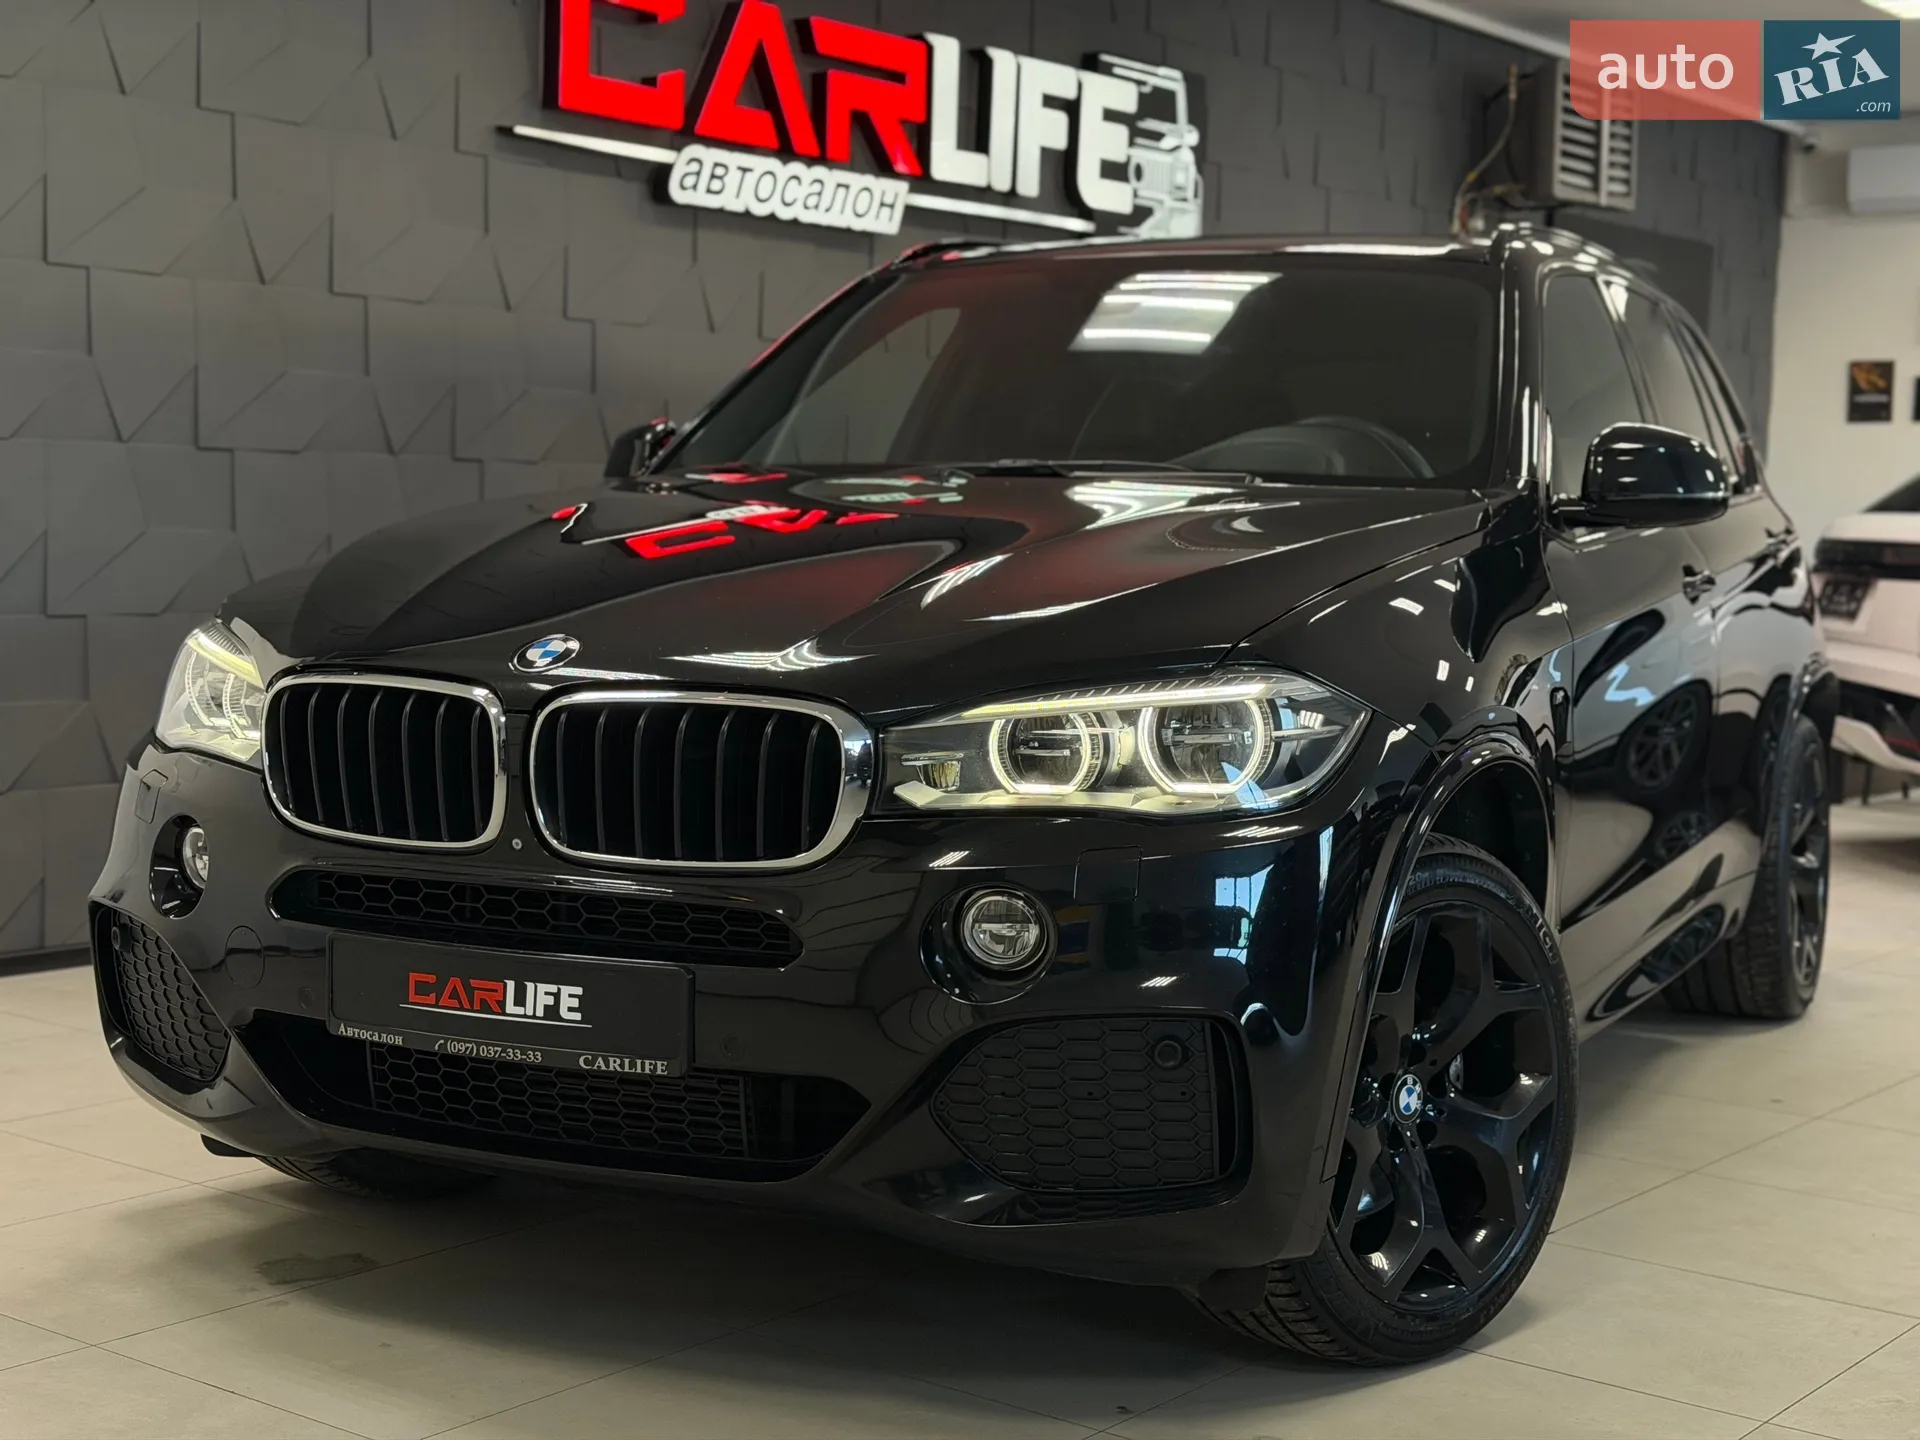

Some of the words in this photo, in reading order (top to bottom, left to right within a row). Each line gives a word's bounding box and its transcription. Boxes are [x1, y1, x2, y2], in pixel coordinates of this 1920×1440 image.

[678, 157, 903, 223] автосалон
[408, 972, 584, 1021] CARLIFE
[338, 1022, 404, 1045] Автосалон
[447, 1039, 477, 1057] (097)
[479, 1045, 542, 1063] 037-33-33
[579, 1054, 668, 1076] CARLIFE
